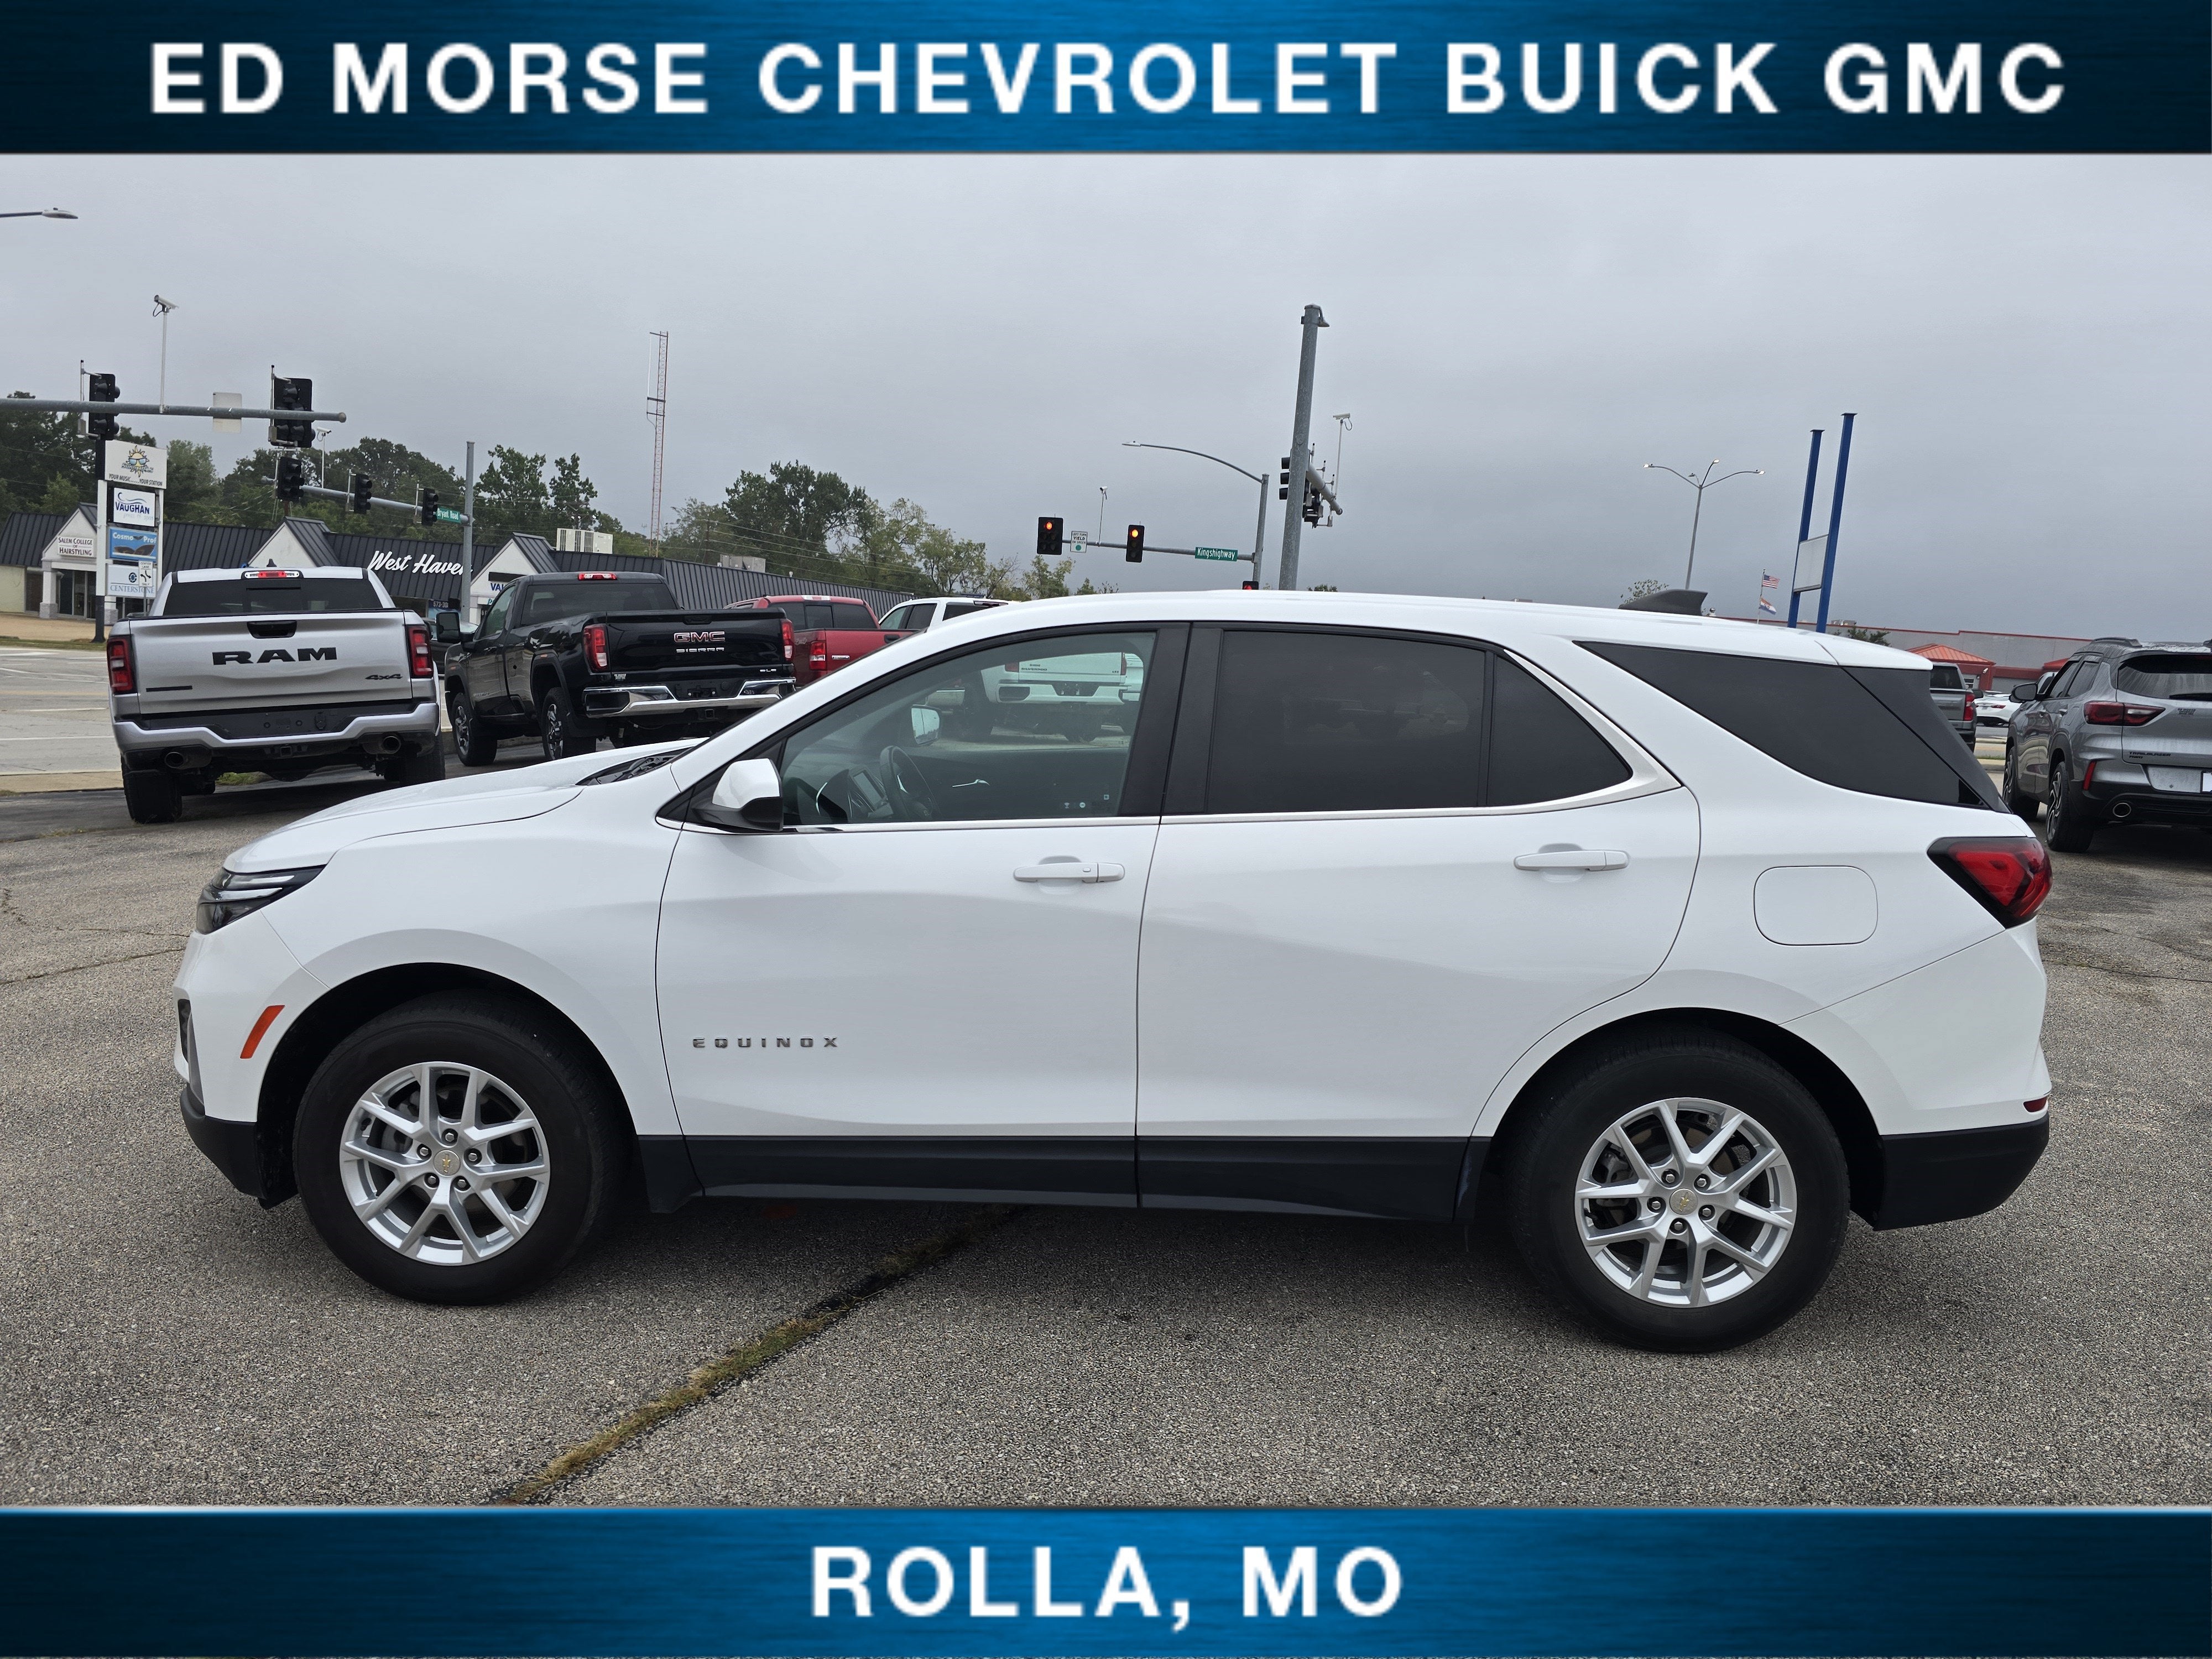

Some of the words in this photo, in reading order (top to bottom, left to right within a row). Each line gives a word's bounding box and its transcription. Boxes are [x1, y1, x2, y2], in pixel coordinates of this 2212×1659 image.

[115, 502, 150, 514] VAUGHAN
[112, 531, 134, 541] Cosmo
[59, 547, 92, 556] HAIRSTYLING
[1197, 547, 1235, 560] Kingshighway
[367, 550, 413, 571] West
[674, 631, 726, 643] GMC
[212, 647, 337, 665] RAM
[692, 1036, 832, 1048] EQUINOX
